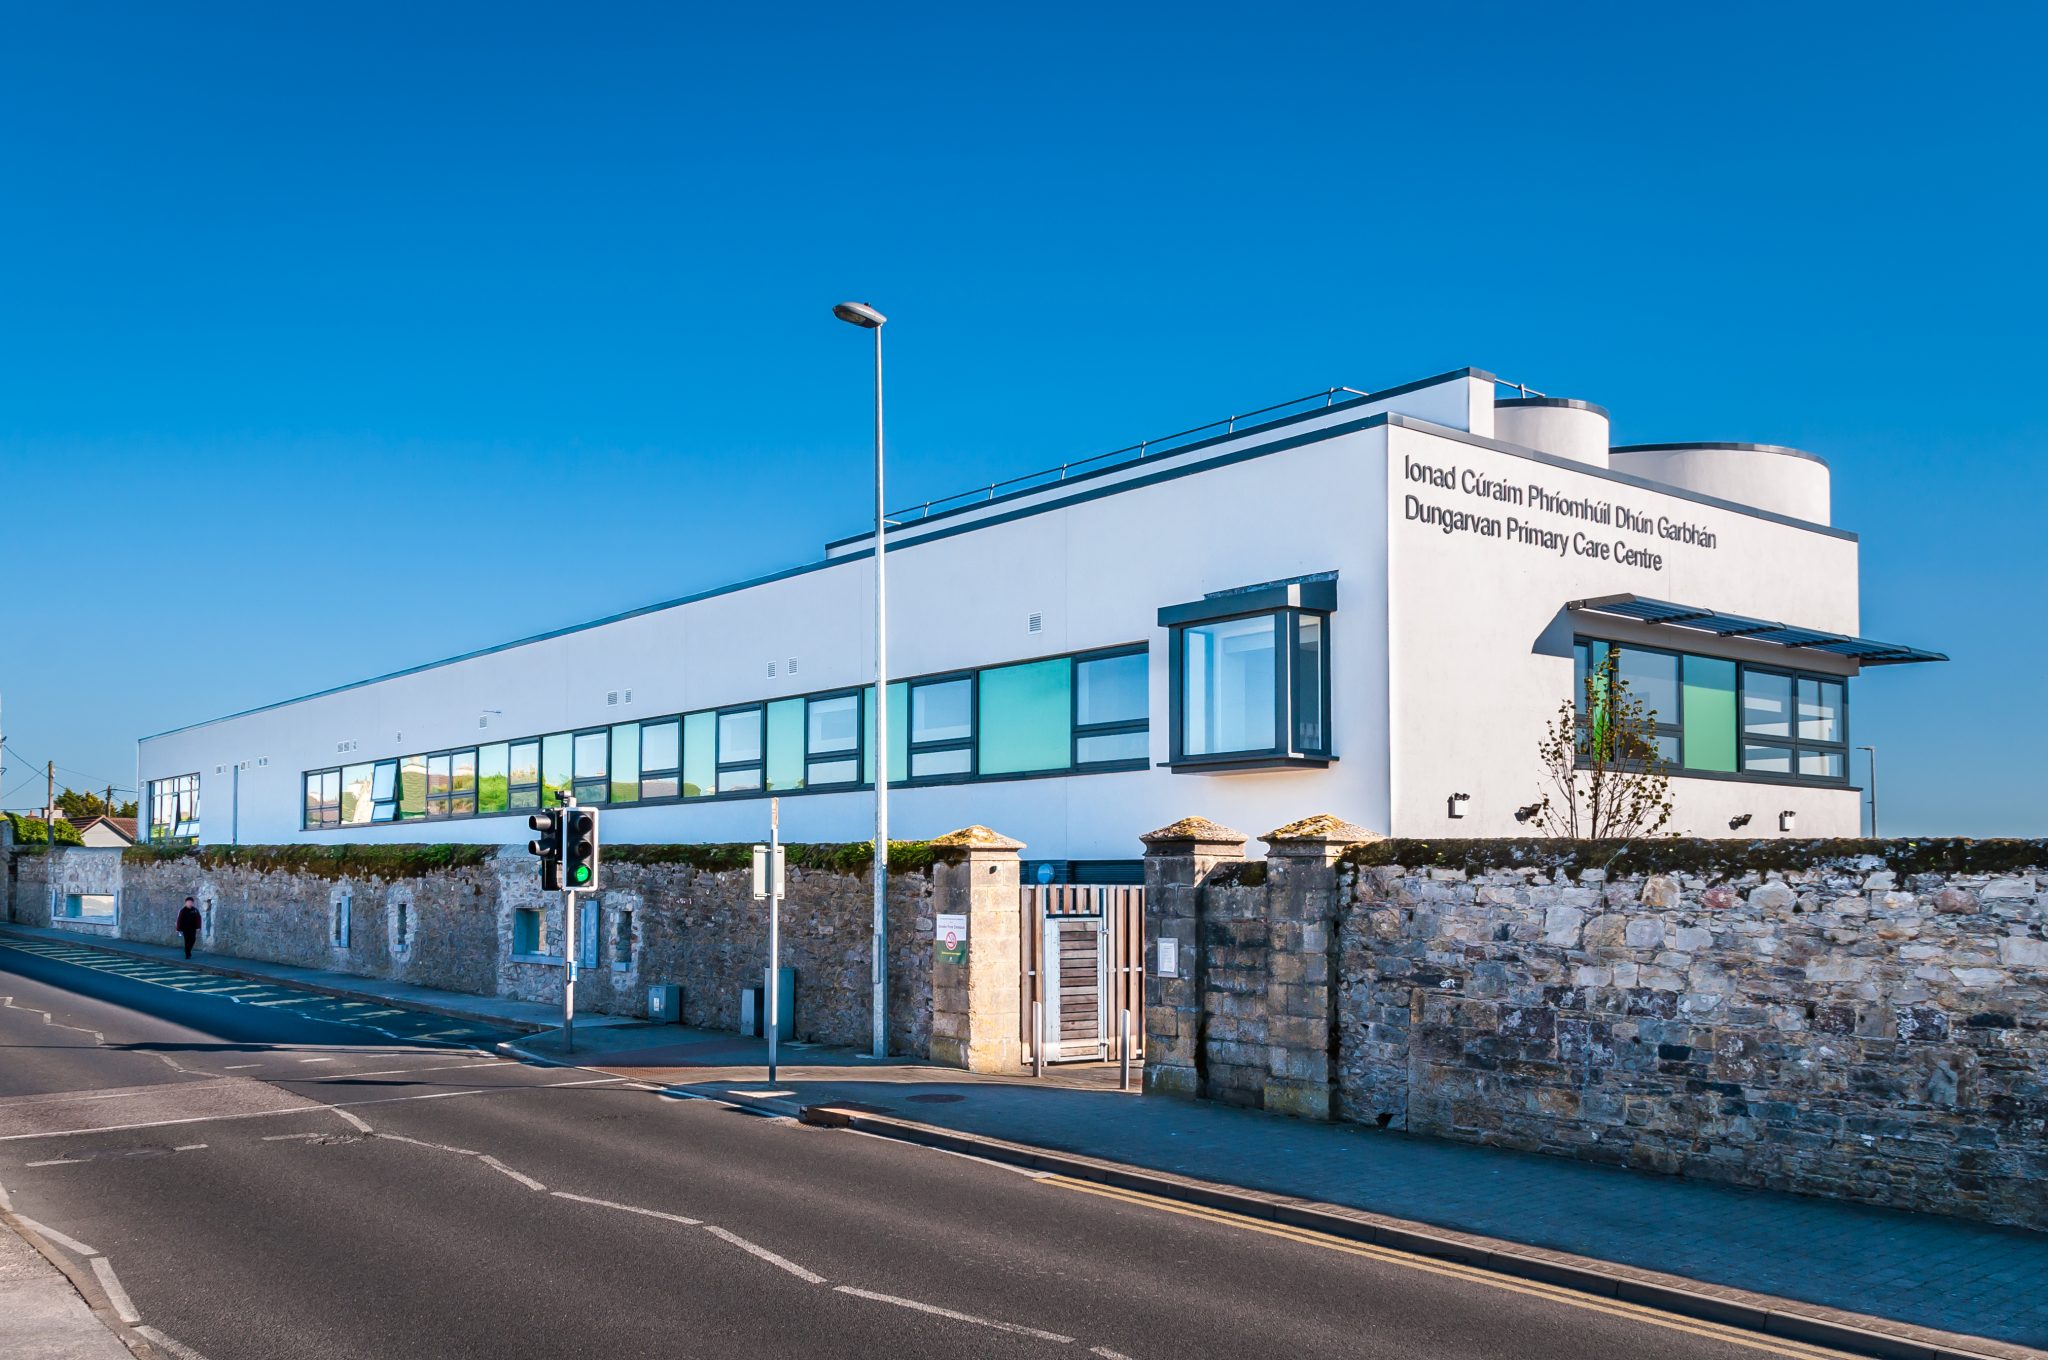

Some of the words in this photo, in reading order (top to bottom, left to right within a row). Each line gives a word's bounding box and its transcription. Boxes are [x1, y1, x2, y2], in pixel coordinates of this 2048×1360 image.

[1405, 455, 1455, 490] Ionad
[1462, 469, 1522, 505] Cúraim
[1529, 485, 1610, 525] Phríomhúil
[1616, 506, 1653, 535] Dhún
[1658, 517, 1716, 549] Garbhán
[1406, 495, 1501, 538] Dungarvan
[1507, 517, 1569, 557] Primary
[1574, 532, 1610, 560] Care
[1614, 541, 1662, 571] Centre
